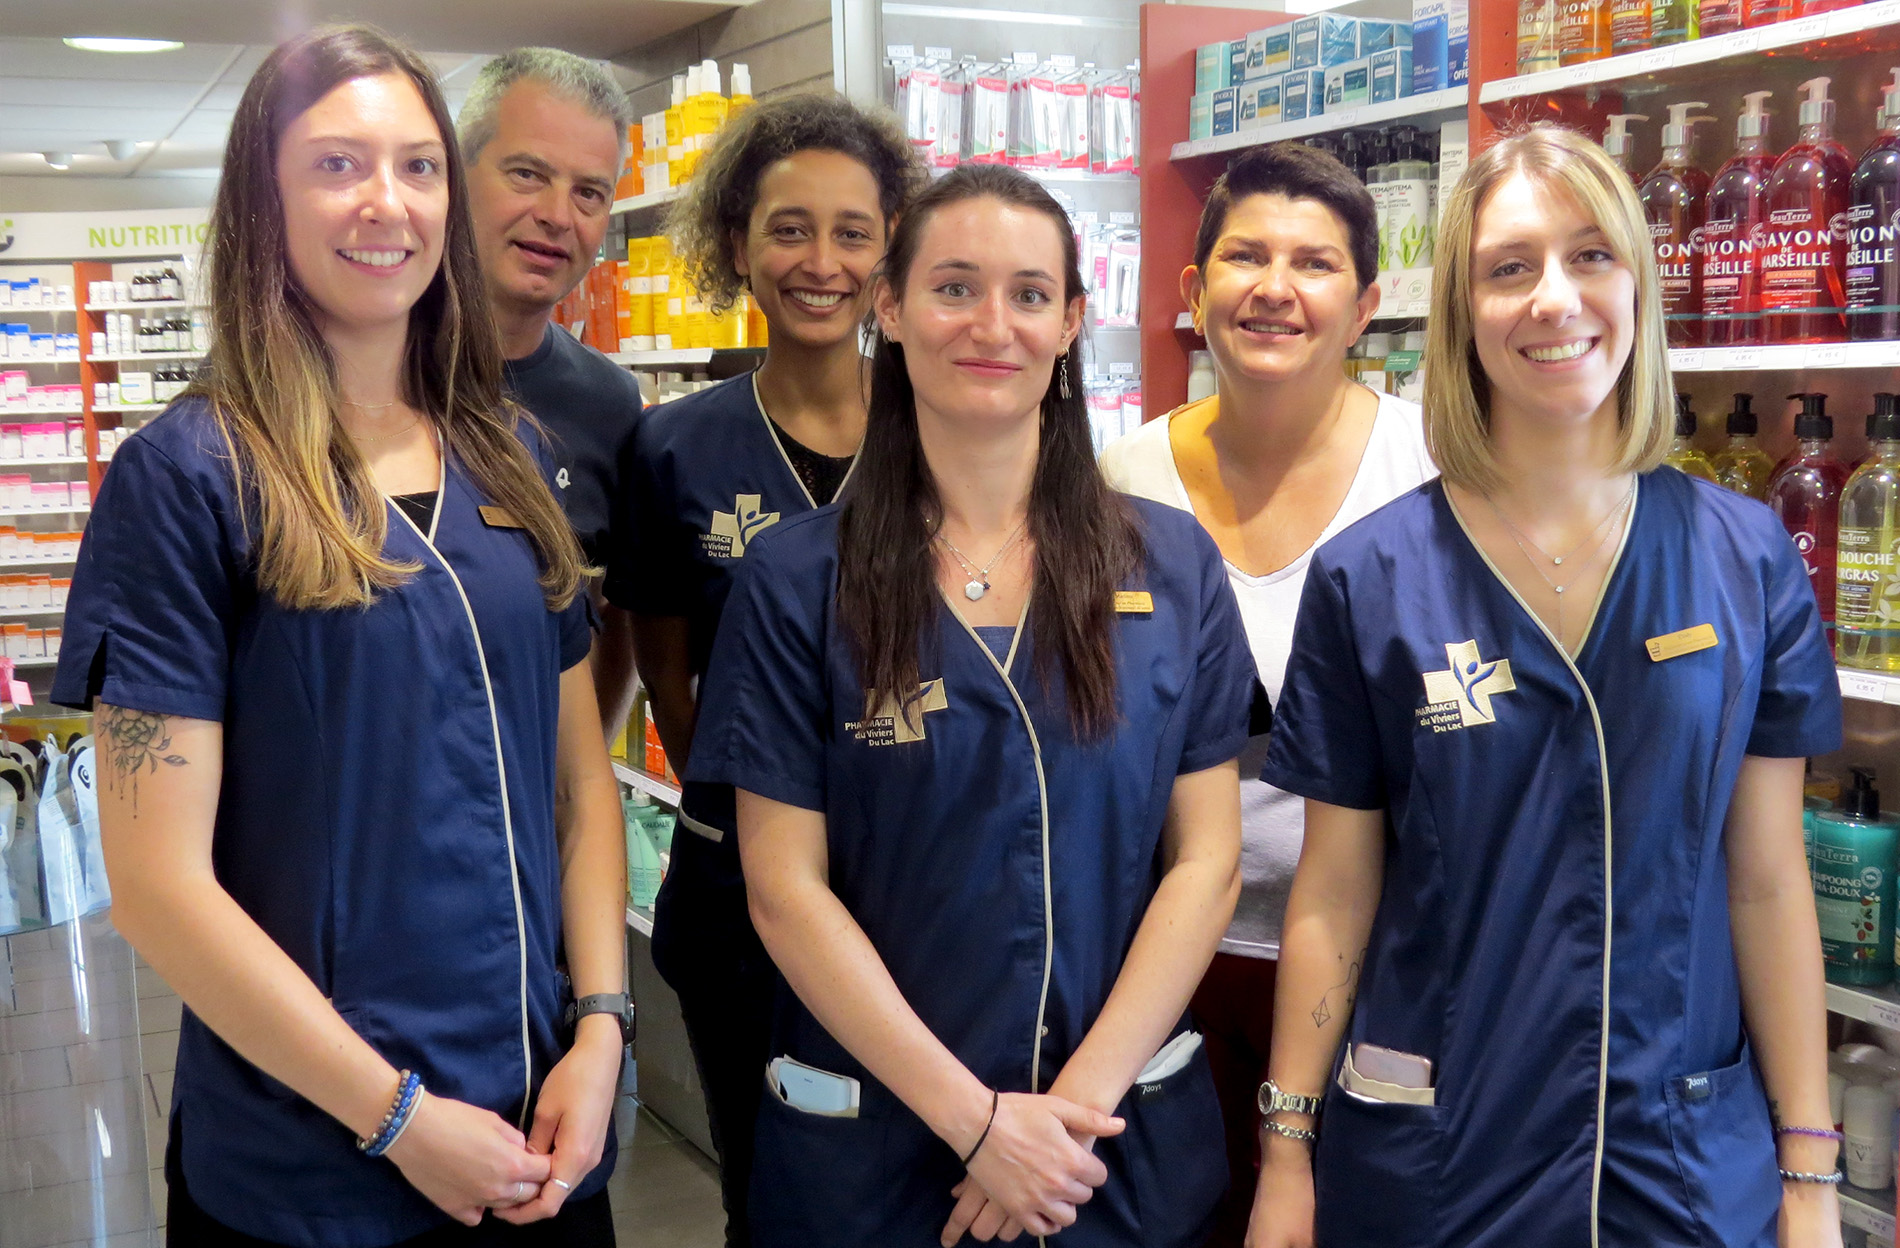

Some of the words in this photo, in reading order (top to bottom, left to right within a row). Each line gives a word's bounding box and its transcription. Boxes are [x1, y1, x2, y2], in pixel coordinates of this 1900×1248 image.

[1453, 68, 1469, 80] OFFE
[88, 222, 208, 248] NUTRITIO
[1841, 551, 1895, 566] DOUCHE
[1420, 717, 1430, 726] du
[1429, 712, 1460, 725] Viviers
[854, 731, 866, 739] du
[866, 728, 894, 738] Viviers
[1433, 724, 1447, 733] Du
[1447, 722, 1463, 731] Lac
[868, 739, 880, 747] Du
[880, 738, 895, 746] Lac
